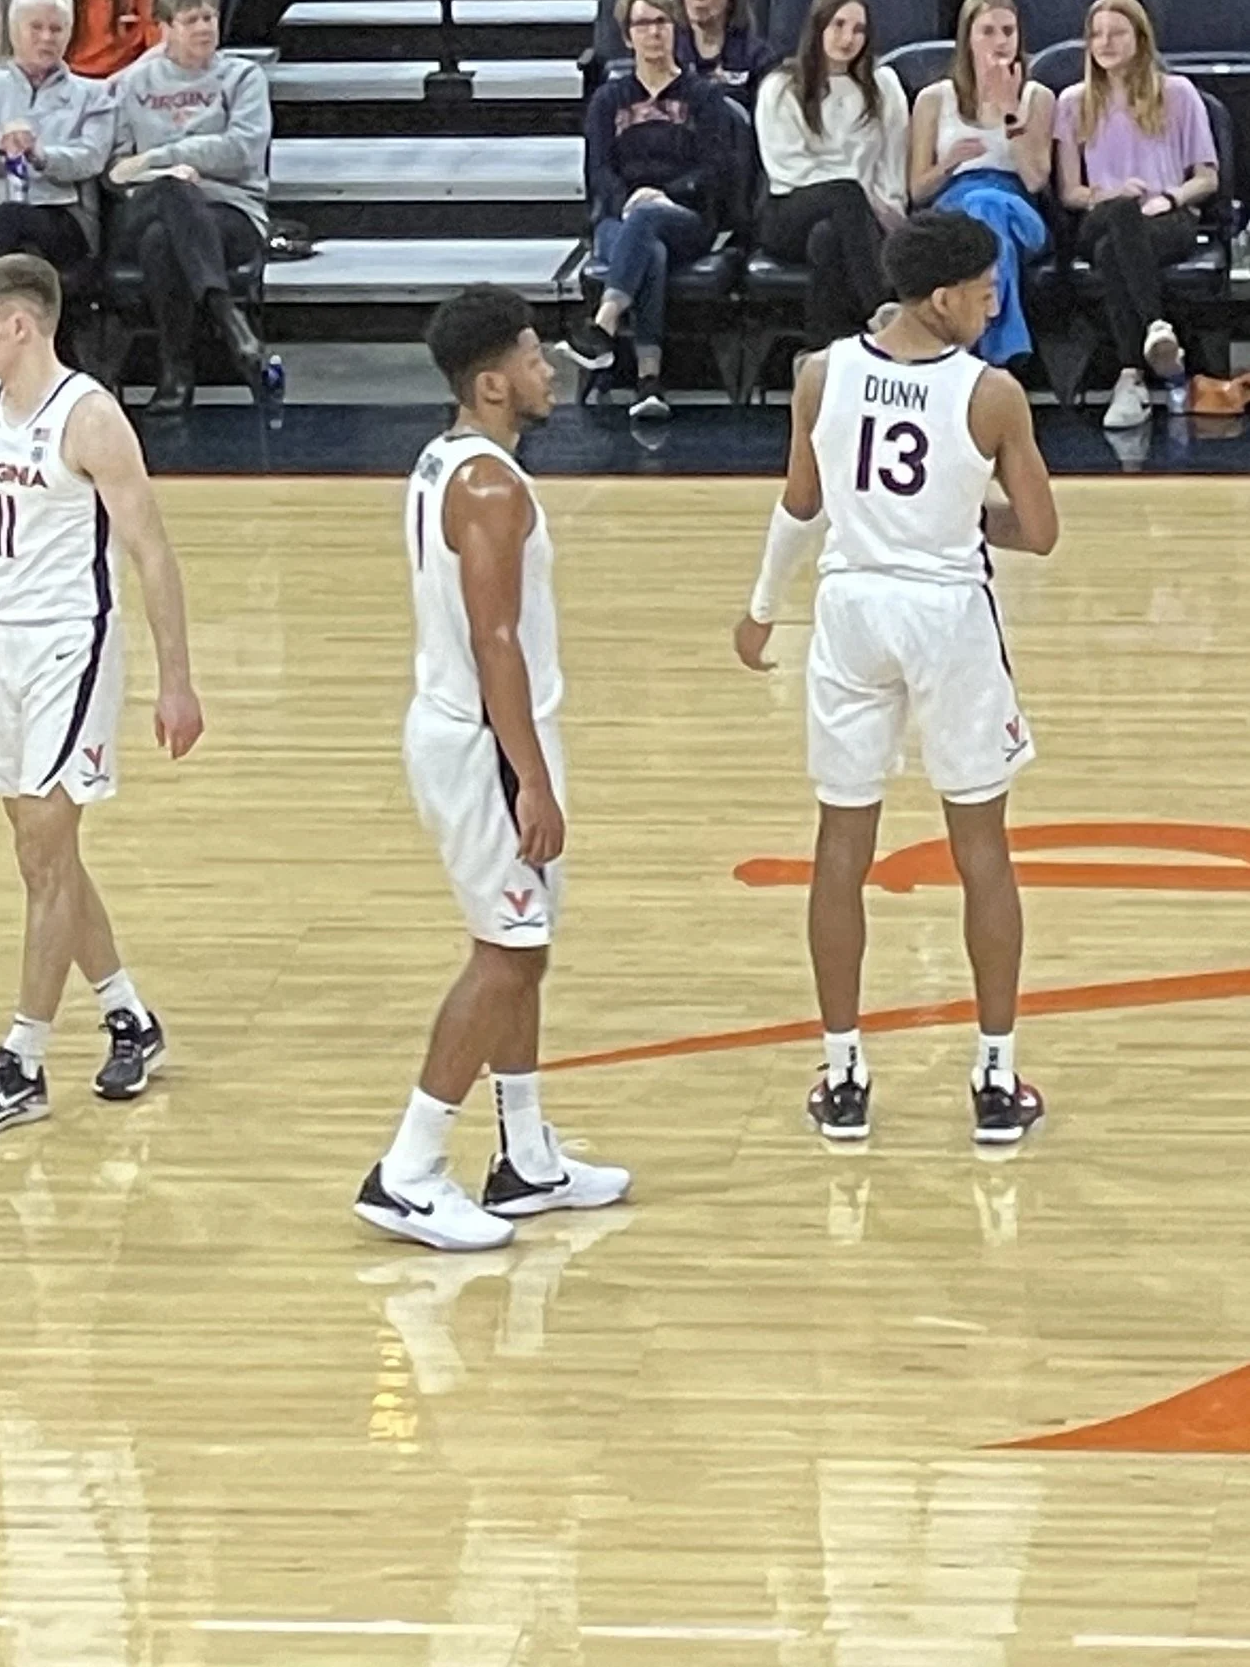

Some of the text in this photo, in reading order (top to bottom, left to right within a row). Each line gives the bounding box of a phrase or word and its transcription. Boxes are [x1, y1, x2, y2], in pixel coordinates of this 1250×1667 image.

[864, 374, 929, 412] DUNN
[856, 415, 929, 496] 13
[416, 491, 425, 571] 1
